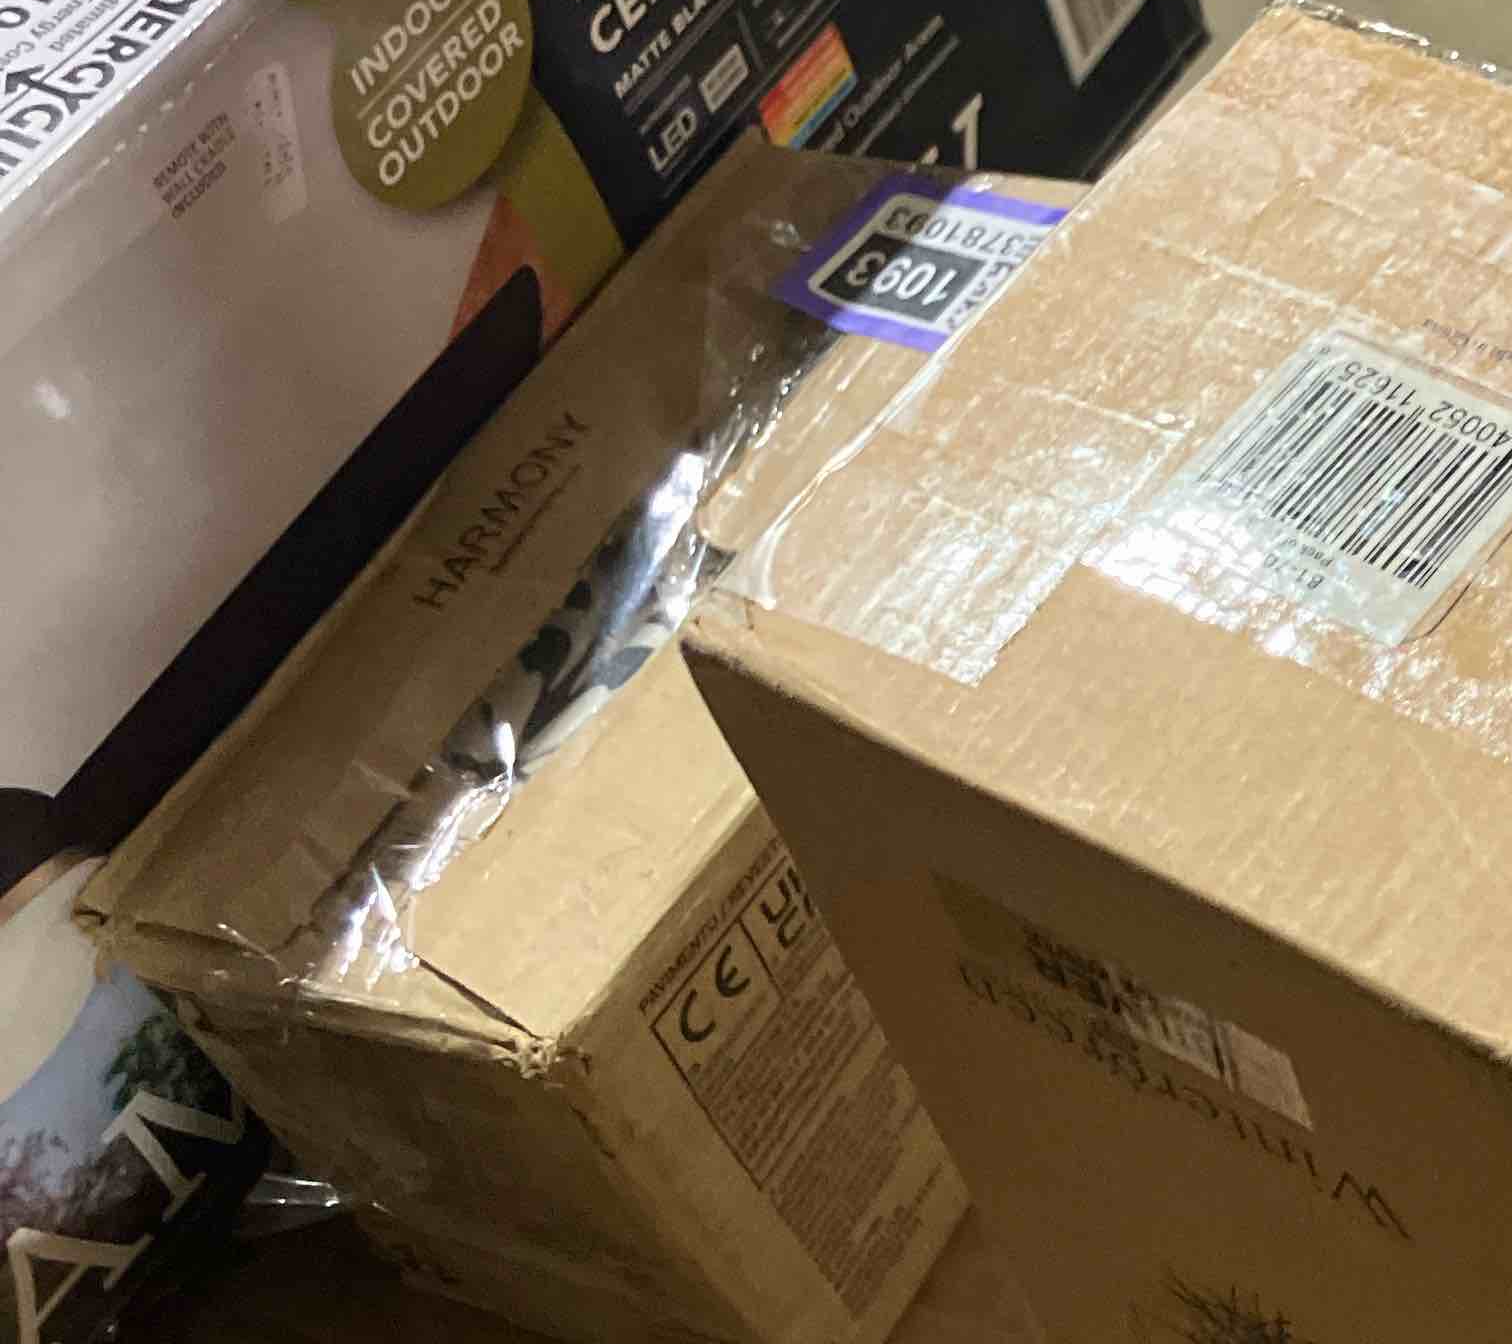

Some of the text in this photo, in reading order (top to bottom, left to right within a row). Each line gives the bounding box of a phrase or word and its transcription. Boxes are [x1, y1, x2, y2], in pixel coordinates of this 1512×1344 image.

[614, 28, 673, 99] MATTE
[376, 26, 527, 189] OUTDOOR
[648, 102, 698, 173] LED
[845, 250, 960, 307] 1093
[1342, 361, 1425, 409] 11625
[412, 408, 593, 612] HARMONY
